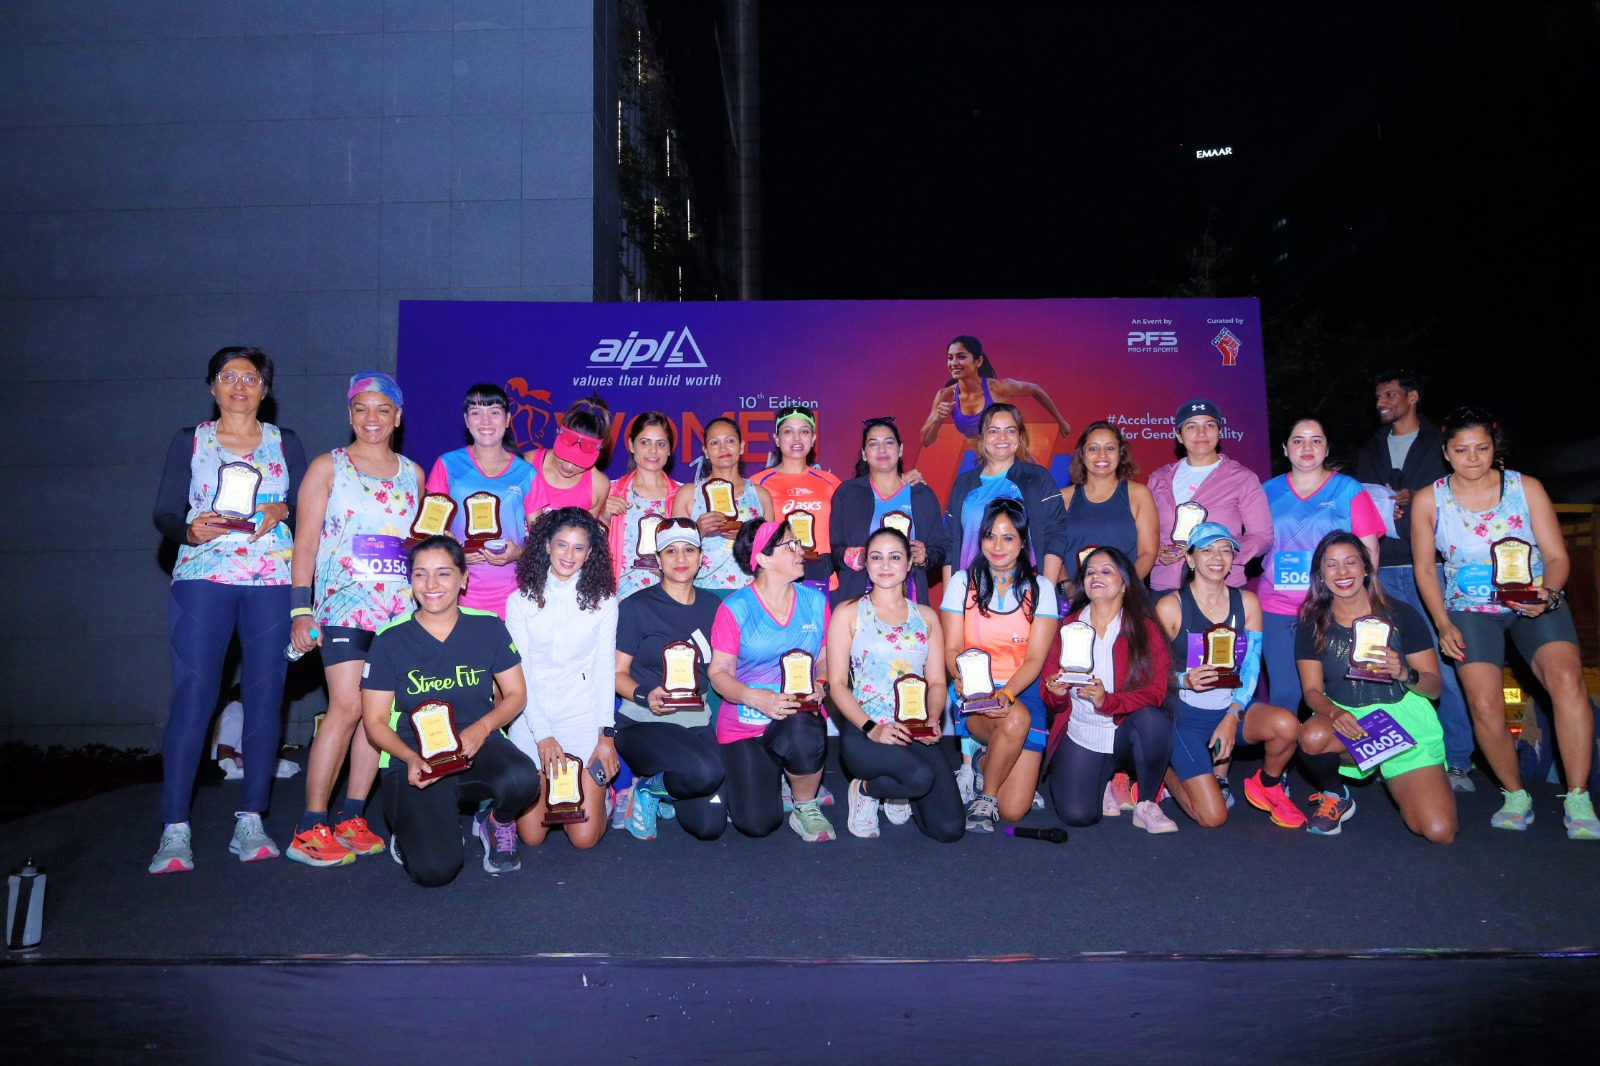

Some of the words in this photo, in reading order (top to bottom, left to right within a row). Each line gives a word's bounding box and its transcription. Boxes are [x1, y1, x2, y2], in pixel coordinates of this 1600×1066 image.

[1196, 147, 1232, 158] EMAAR
[1128, 332, 1177, 346] PFS
[573, 374, 613, 386] values
[618, 374, 644, 386] that
[648, 374, 681, 386] build
[685, 374, 721, 386] worth
[769, 395, 818, 408] Edition
[1107, 413, 1176, 425] #Accelerat
[1120, 428, 1138, 439] for
[1141, 428, 1176, 439] Gend
[361, 559, 407, 574] 10356
[407, 669, 455, 695] Stree
[455, 665, 486, 688] Fit
[1355, 730, 1404, 760] 10605
